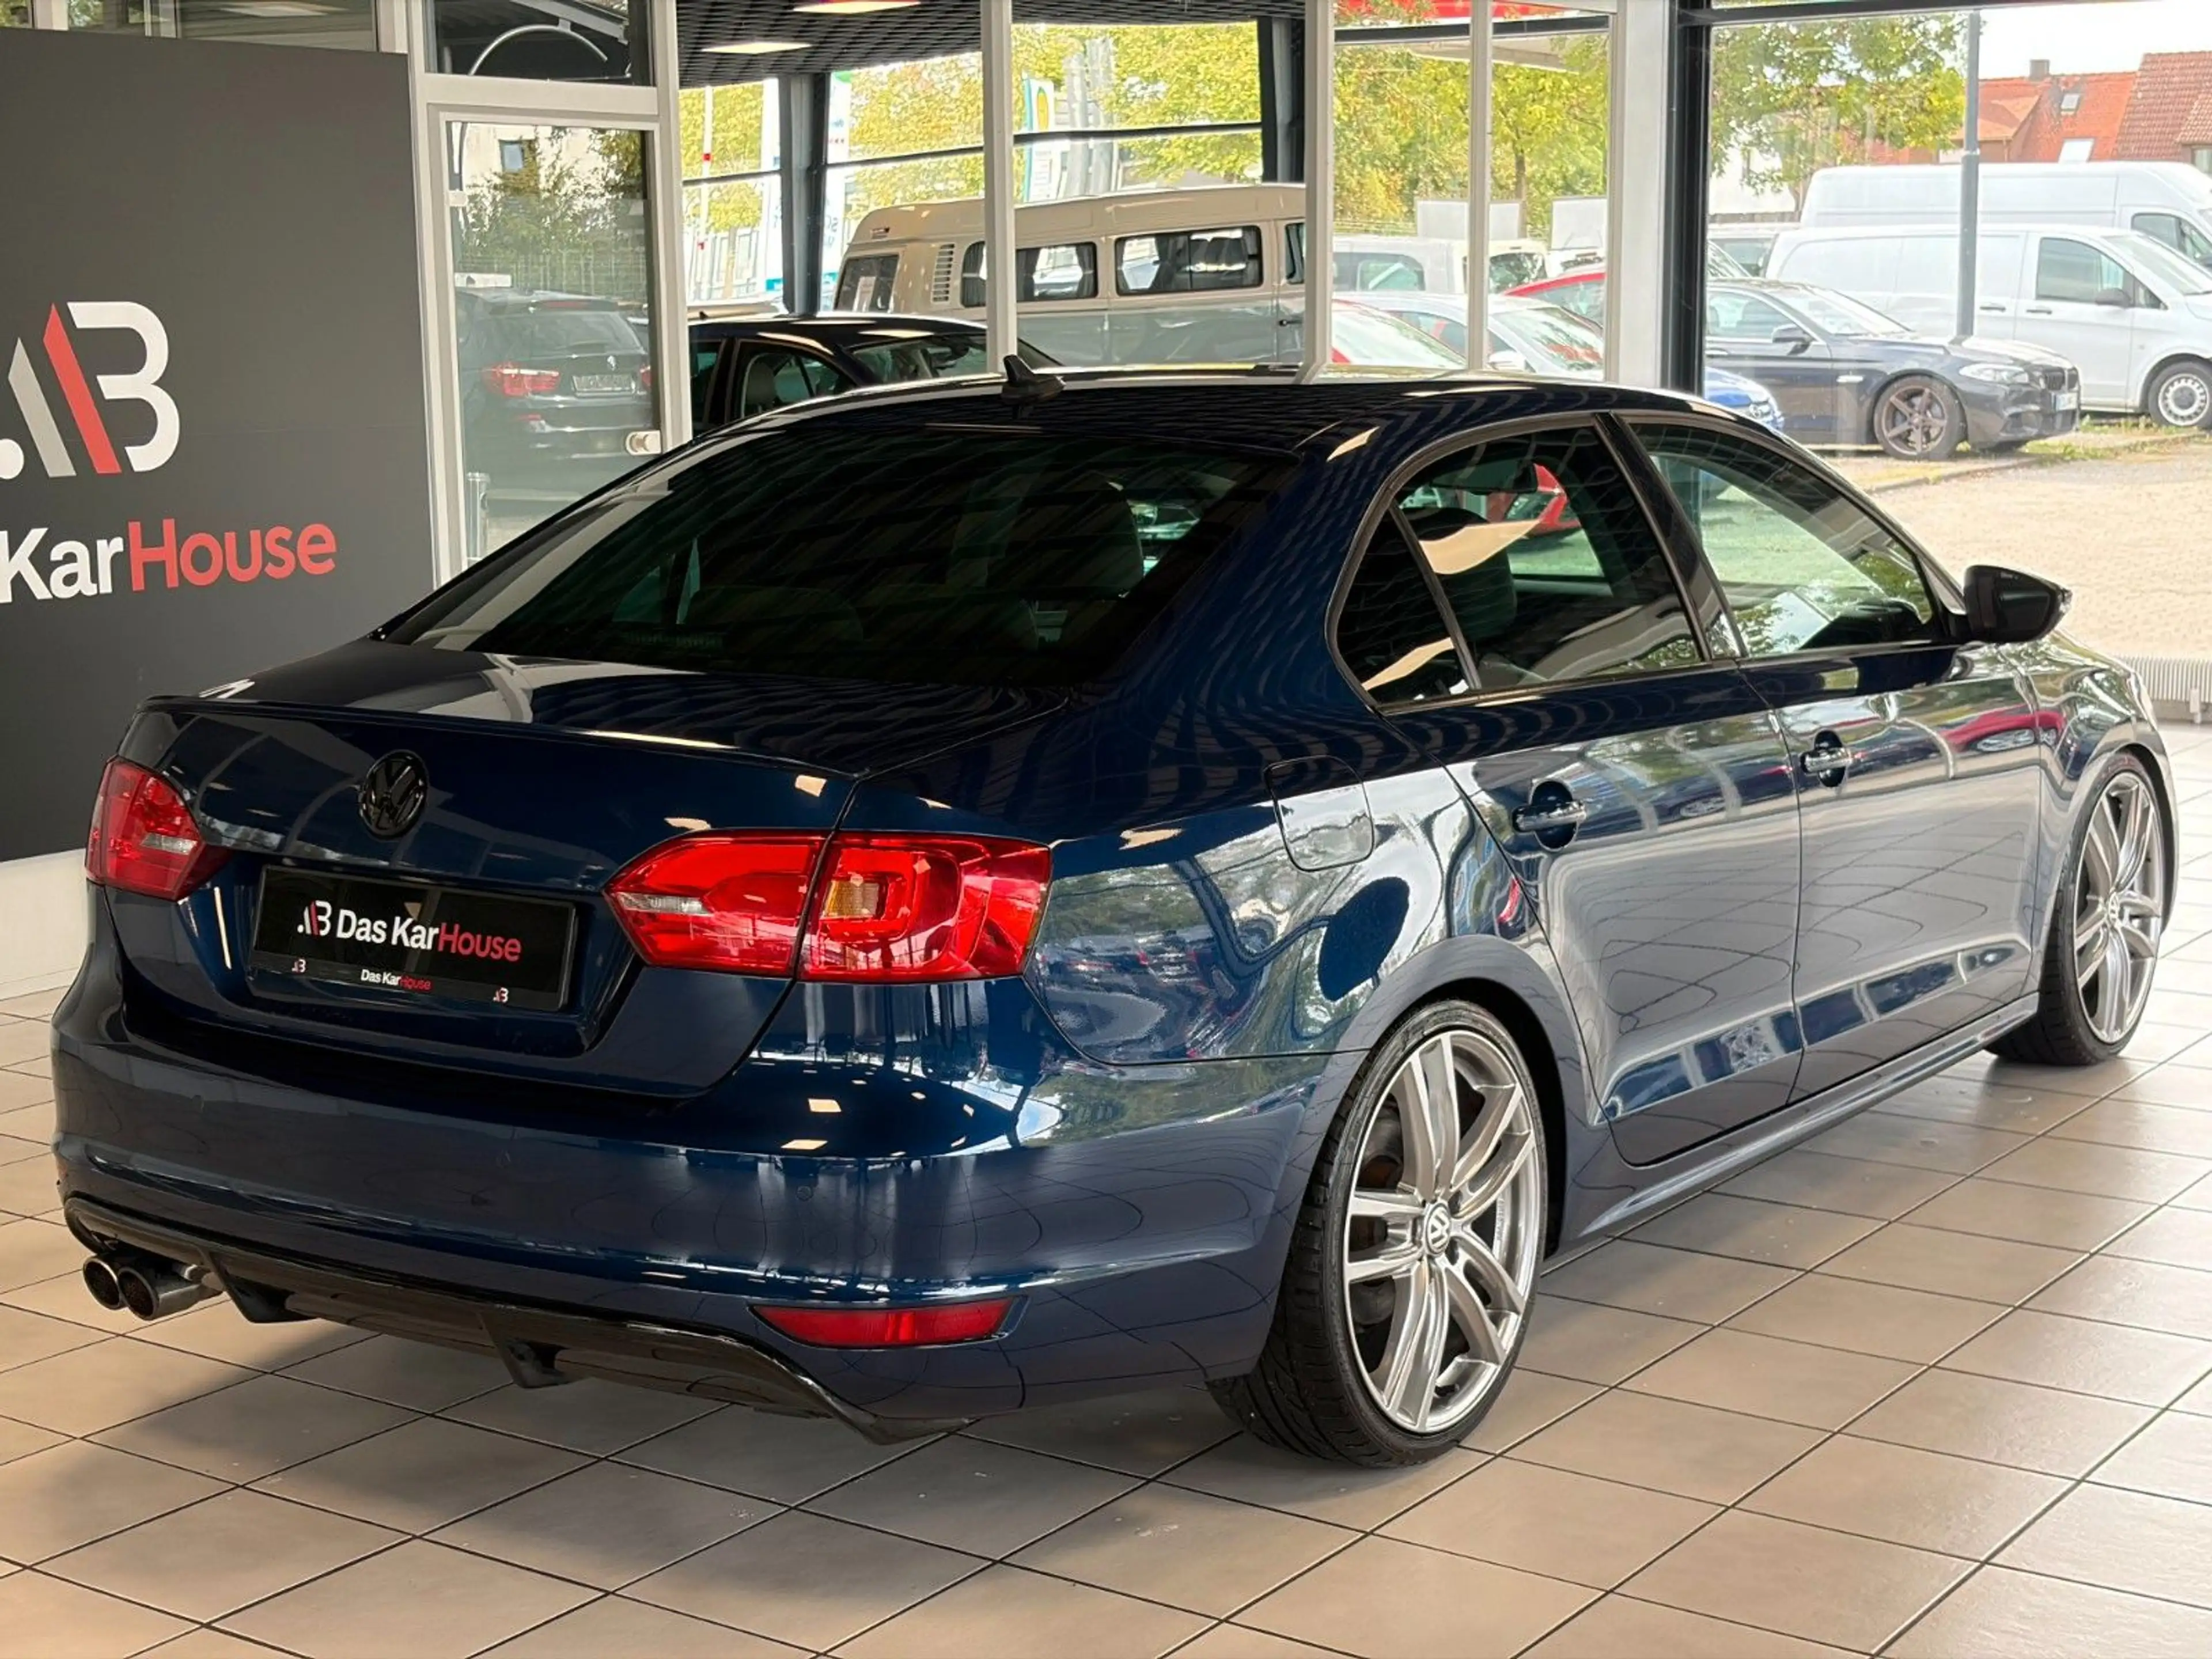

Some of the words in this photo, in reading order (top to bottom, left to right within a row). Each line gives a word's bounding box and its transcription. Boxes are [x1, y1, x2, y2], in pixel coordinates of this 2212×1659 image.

[336, 909, 387, 944] Das
[391, 916, 522, 962] KarHouse
[361, 969, 382, 984] Das
